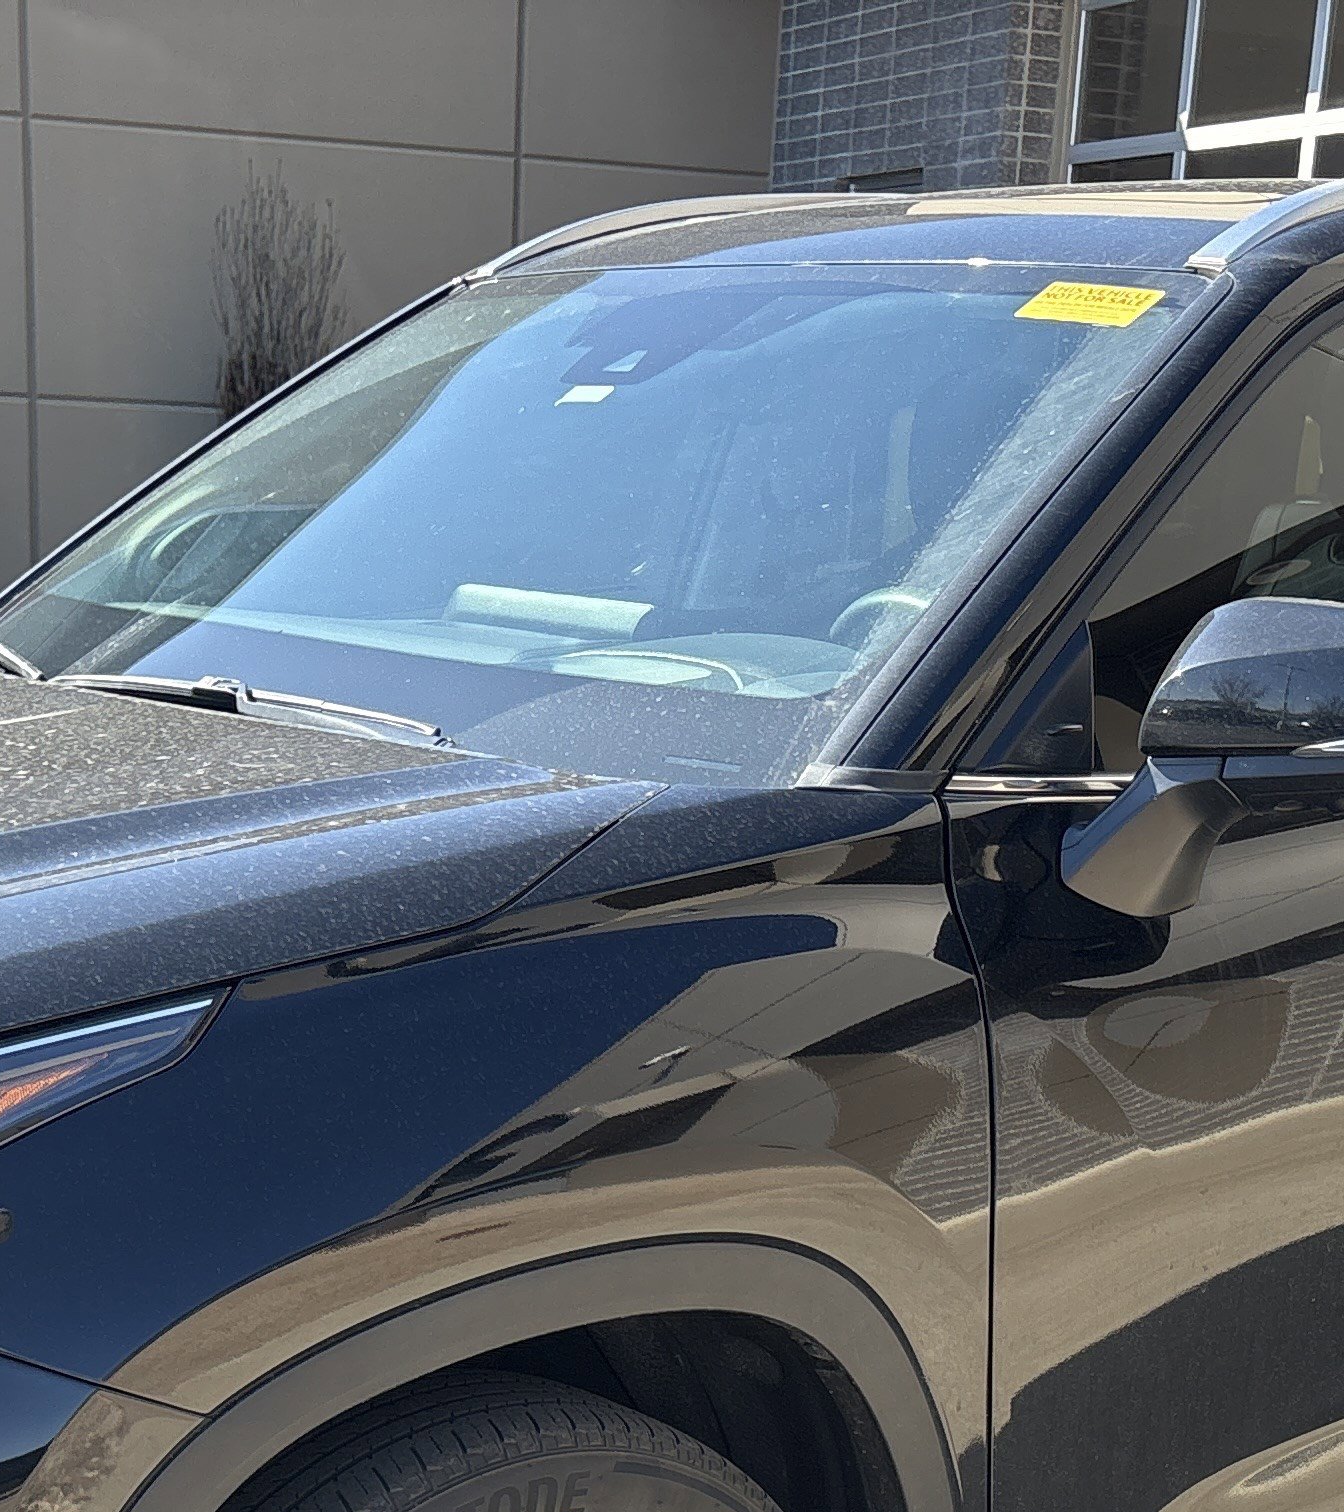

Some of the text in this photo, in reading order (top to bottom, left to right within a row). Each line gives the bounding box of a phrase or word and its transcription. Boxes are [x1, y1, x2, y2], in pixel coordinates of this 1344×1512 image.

[1042, 292, 1072, 301] NOT
[1074, 294, 1105, 303] FOR
[1109, 297, 1146, 307] SALE
[1050, 285, 1157, 301] THIS VEHICLE
